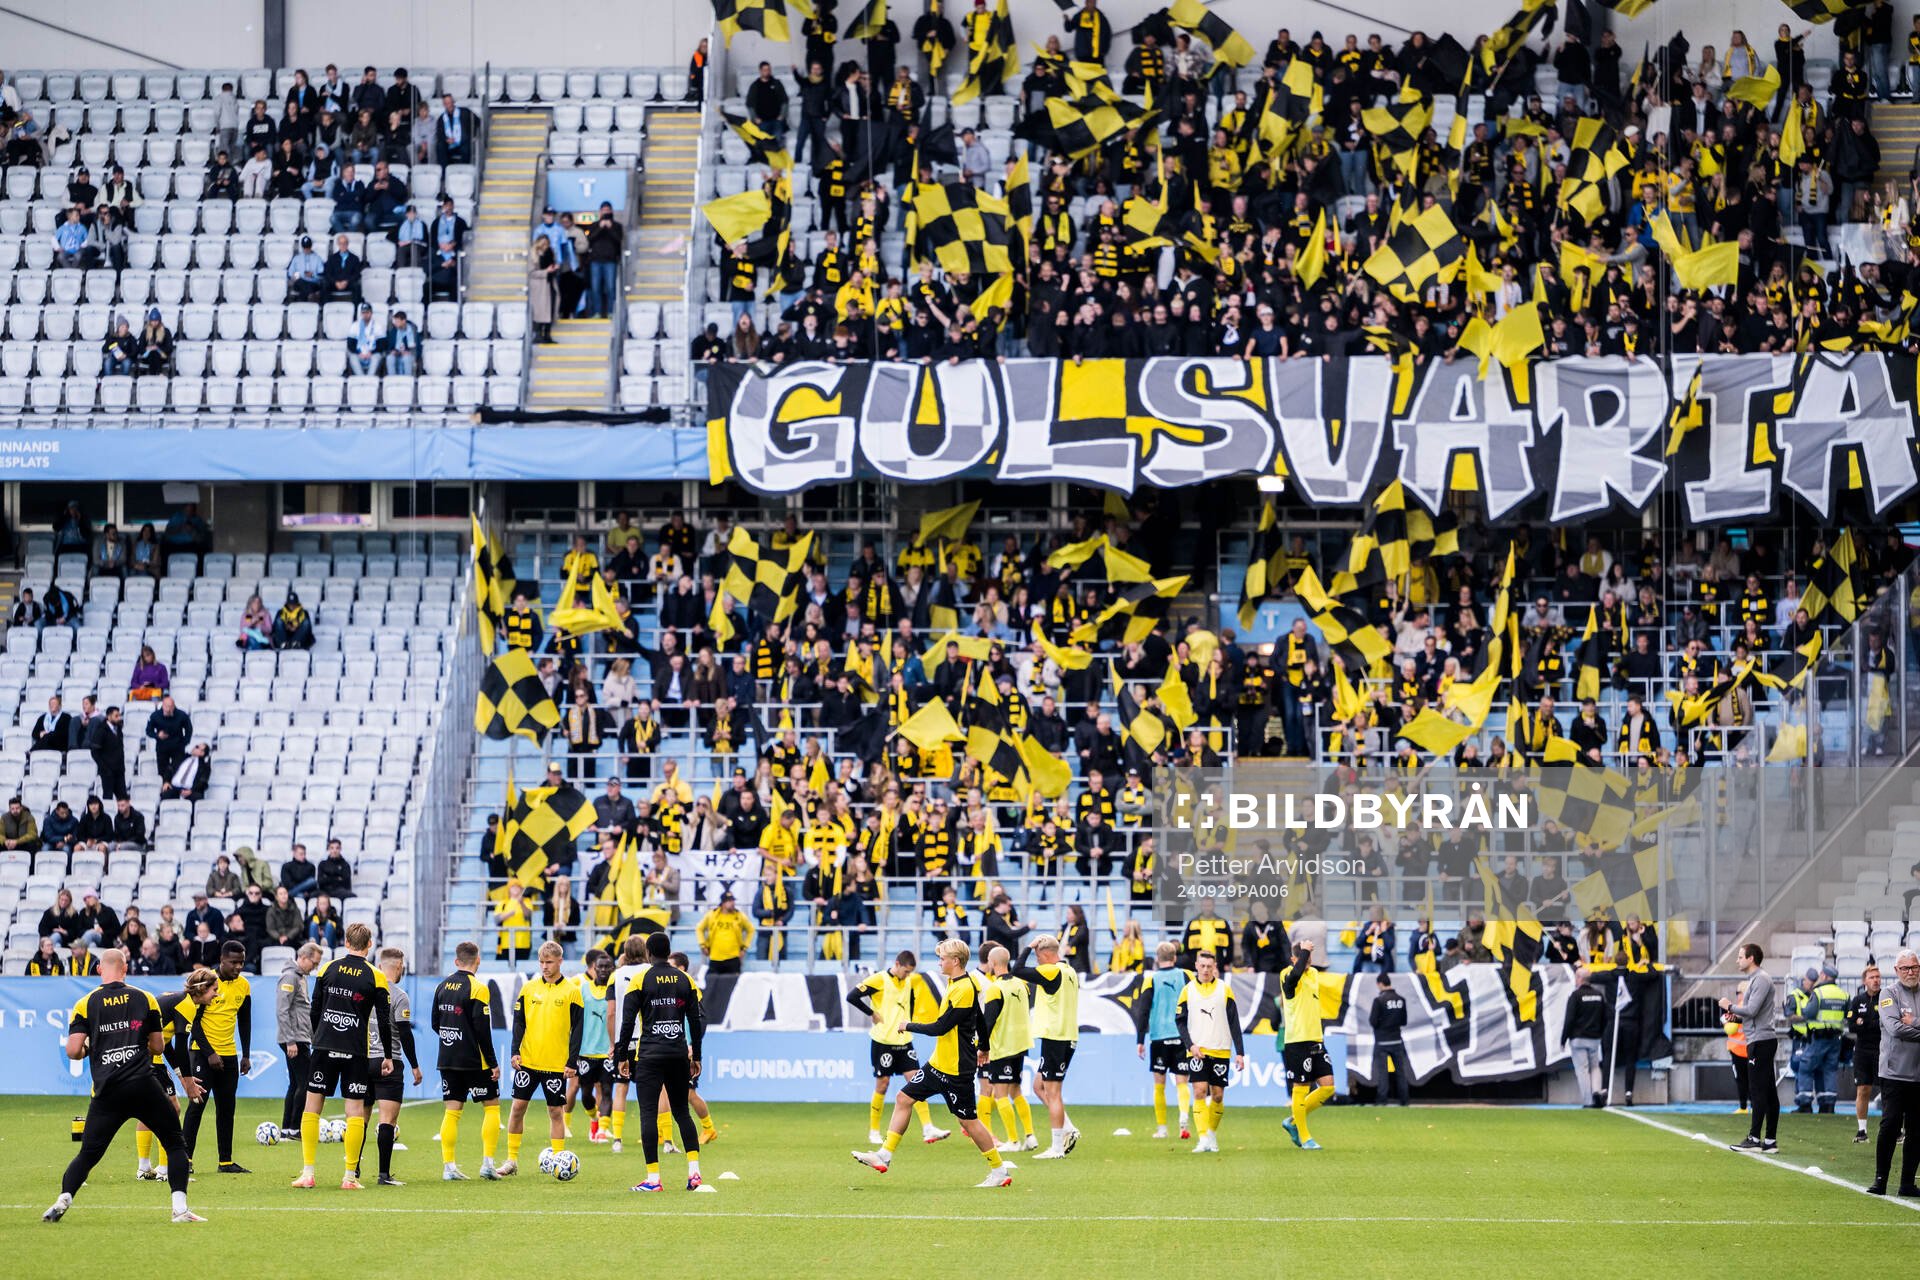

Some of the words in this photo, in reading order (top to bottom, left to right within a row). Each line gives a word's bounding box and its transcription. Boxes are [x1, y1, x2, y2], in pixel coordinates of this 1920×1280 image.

[338, 965, 363, 977] MAIF
[656, 975, 679, 984] MAIF
[444, 982, 463, 991] MAIF
[103, 993, 130, 1007] MAIF
[717, 1058, 855, 1079] FOUNDATION
